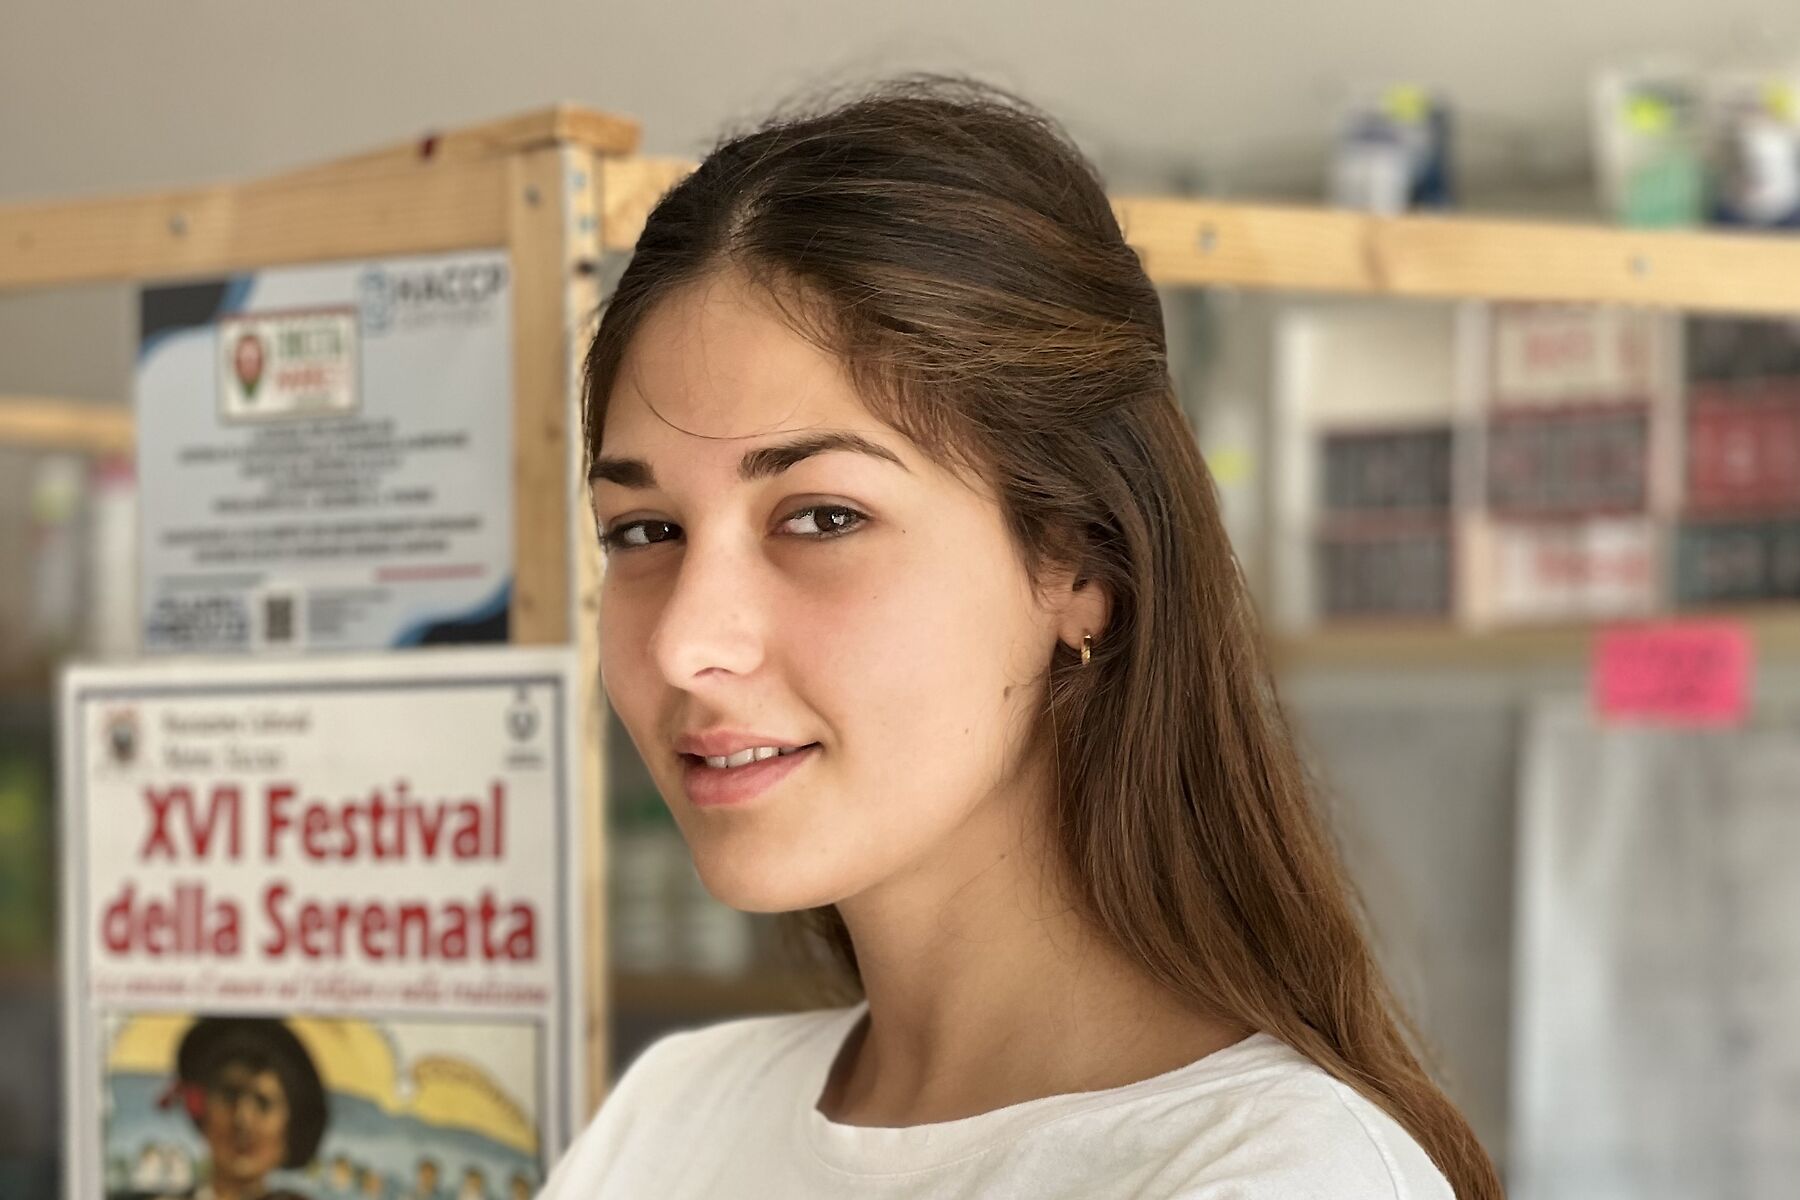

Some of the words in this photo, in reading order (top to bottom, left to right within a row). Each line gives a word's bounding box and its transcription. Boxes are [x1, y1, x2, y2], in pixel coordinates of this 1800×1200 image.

[143, 785, 241, 862] XVI
[265, 779, 505, 862] Festival
[102, 883, 240, 959] della
[264, 883, 538, 961] Serenata
